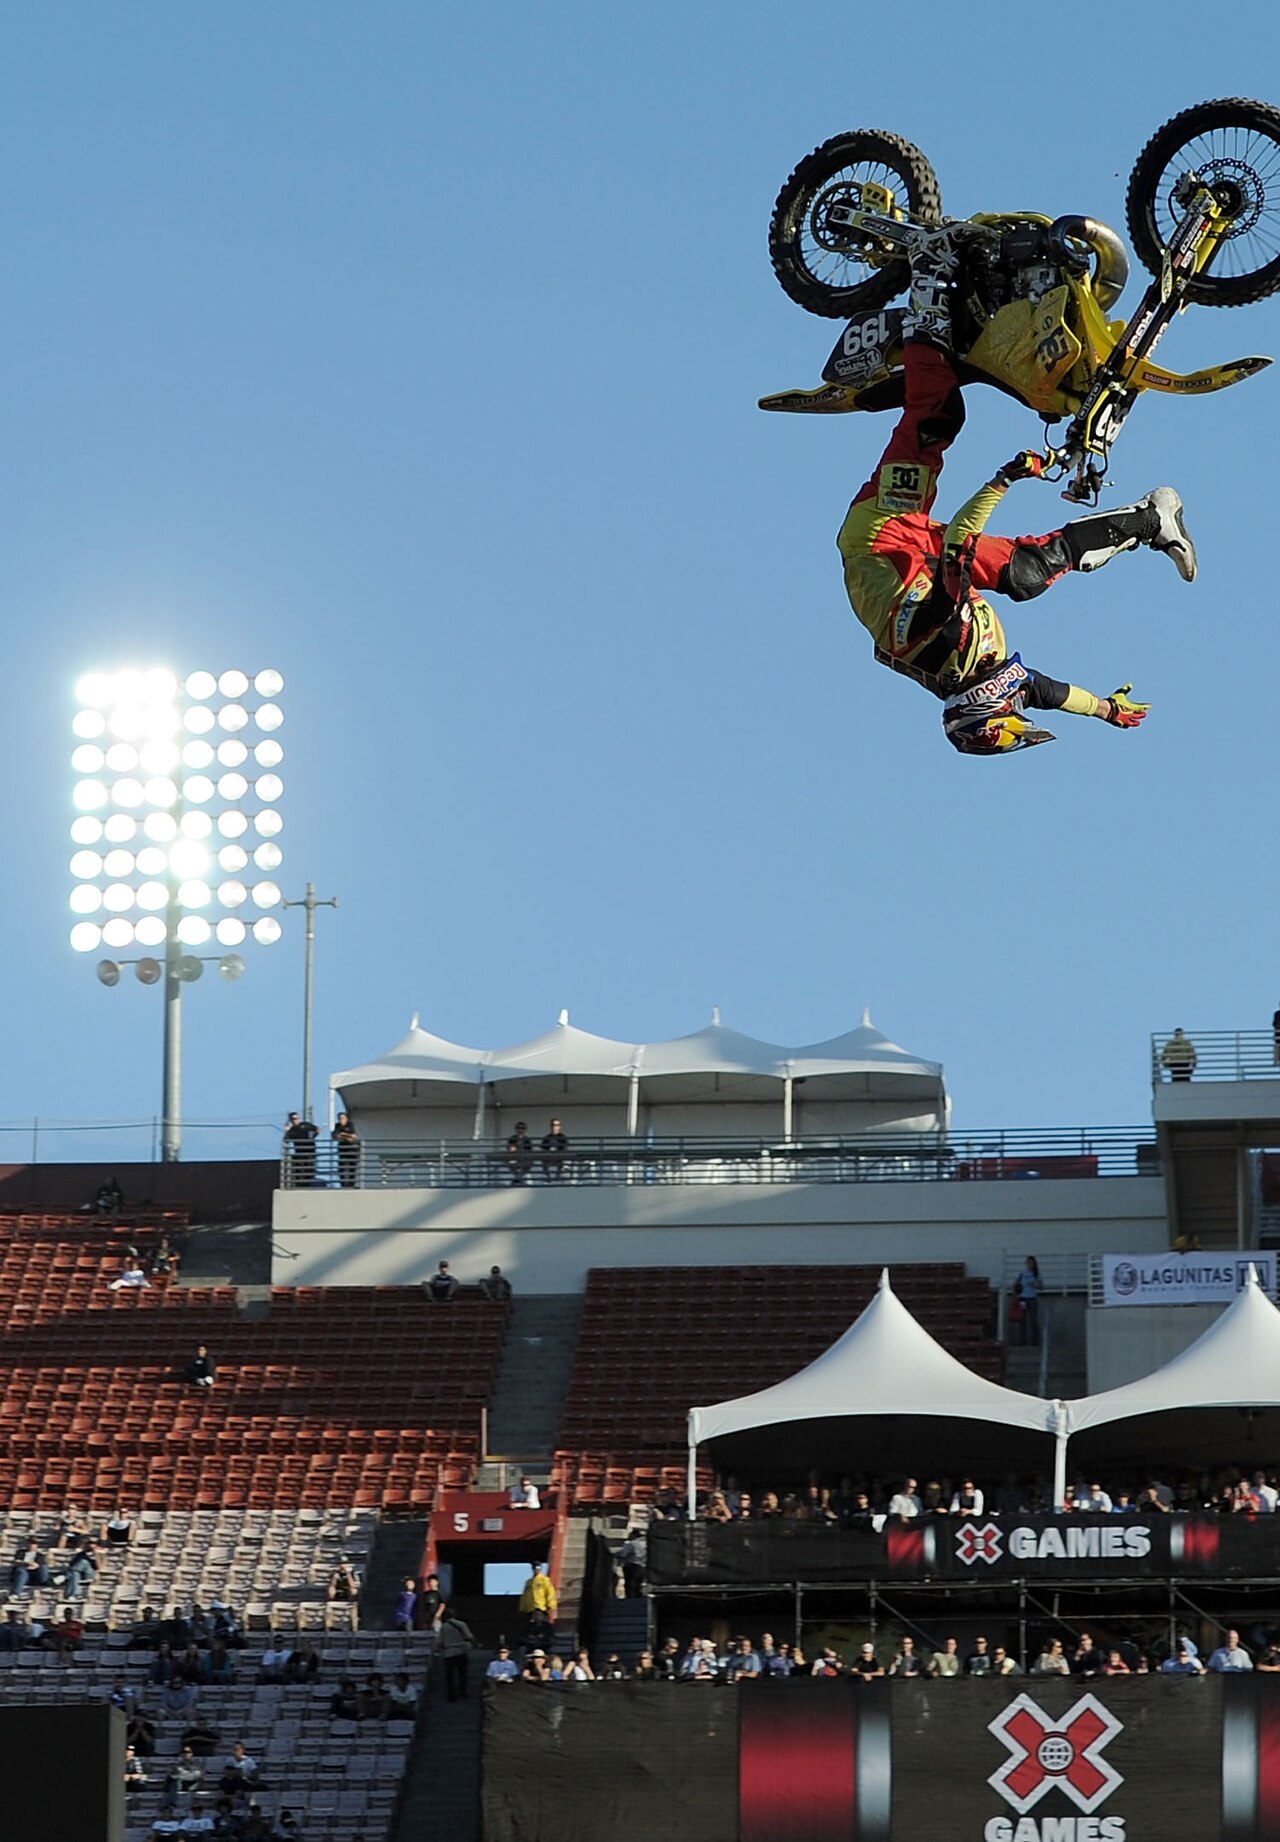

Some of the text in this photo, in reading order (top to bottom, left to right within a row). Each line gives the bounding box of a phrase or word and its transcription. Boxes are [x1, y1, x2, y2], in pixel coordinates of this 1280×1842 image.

[843, 312, 890, 356] 199
[1144, 373, 1170, 386] MOTUL
[896, 590, 920, 645] SUZUKI
[1140, 1267, 1234, 1286] LAGUNITAS
[453, 1512, 470, 1532] 5
[1008, 1525, 1151, 1559] GAMES
[983, 1815, 1127, 1842] GAMES
